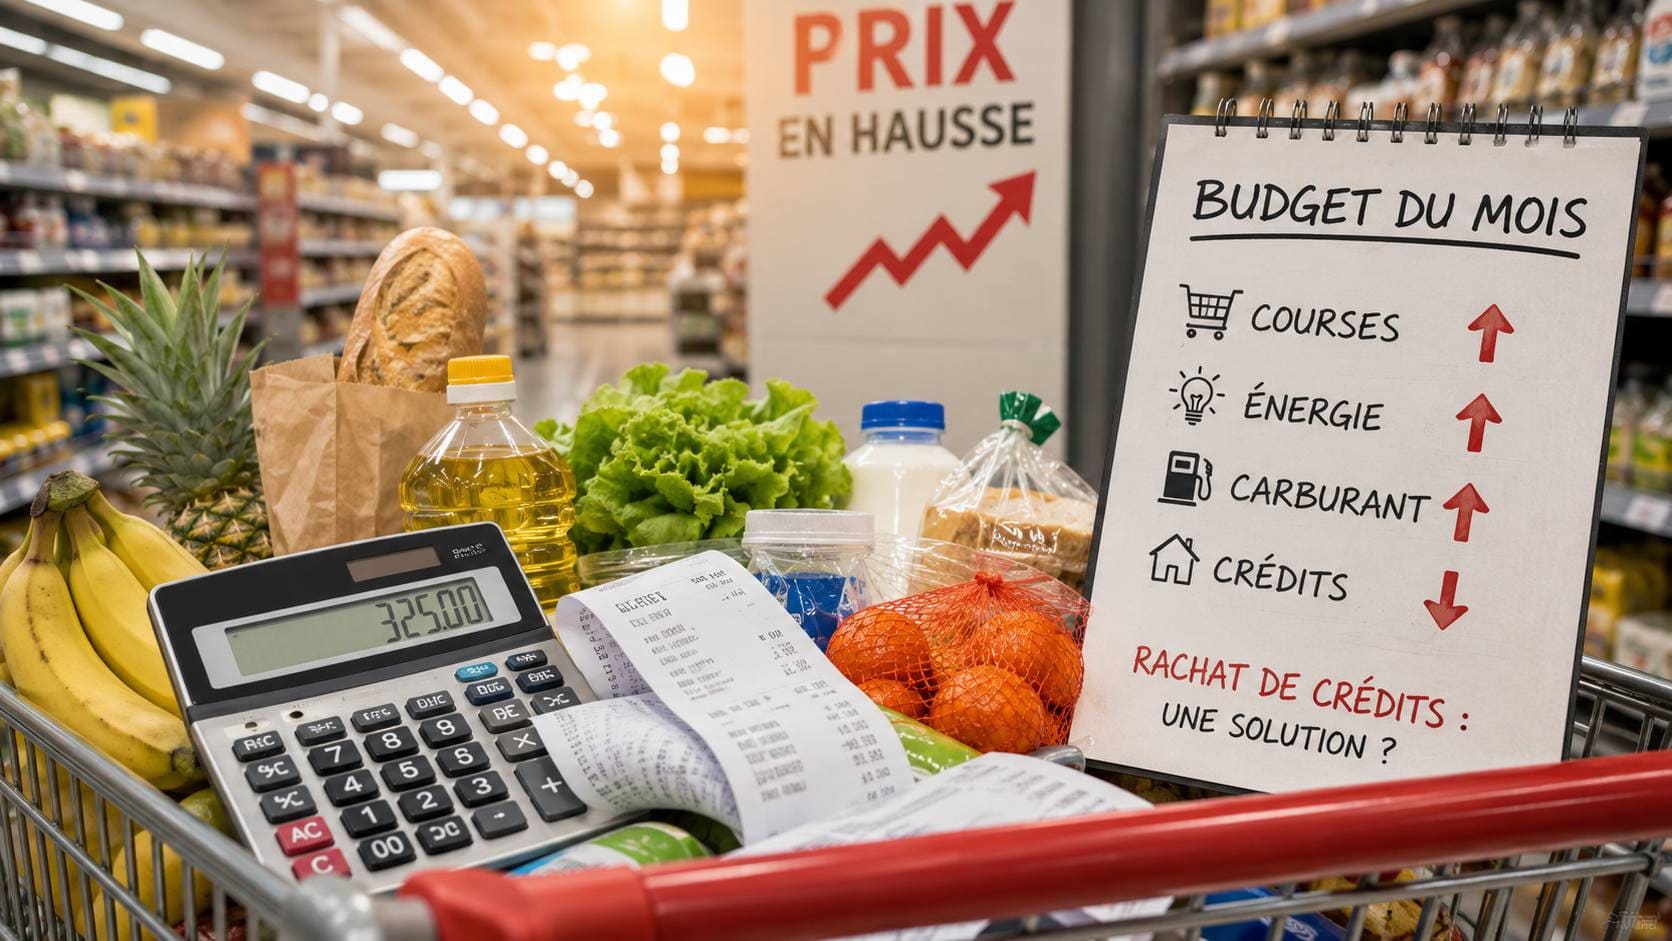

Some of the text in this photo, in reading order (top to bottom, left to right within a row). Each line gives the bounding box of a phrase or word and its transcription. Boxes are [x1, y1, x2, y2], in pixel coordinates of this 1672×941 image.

[793, 0, 1016, 96] PRIX
[779, 101, 1035, 160] EN HAUSSE
[1193, 180, 1587, 238] BUDGET DU MOIS
[1252, 304, 1400, 342] COURSES
[1244, 382, 1384, 430] ÉNERGIE
[1231, 474, 1431, 523] CARBURANT
[1214, 554, 1348, 601] CRÉDITS
[375, 585, 483, 643] 325.00
[1134, 646, 1249, 690] RACHAT
[1260, 668, 1299, 700] DE
[1313, 677, 1445, 729] CRÉDITS
[381, 732, 402, 749] 8
[1163, 703, 1397, 764] UNE SOLUTION ?
[324, 744, 342, 763] 7
[398, 761, 419, 778] 5
[344, 775, 363, 792] 4
[416, 791, 438, 810] 2
[471, 777, 492, 794] 3
[291, 822, 323, 843] AC
[360, 806, 378, 824] 1
[311, 855, 334, 874] C
